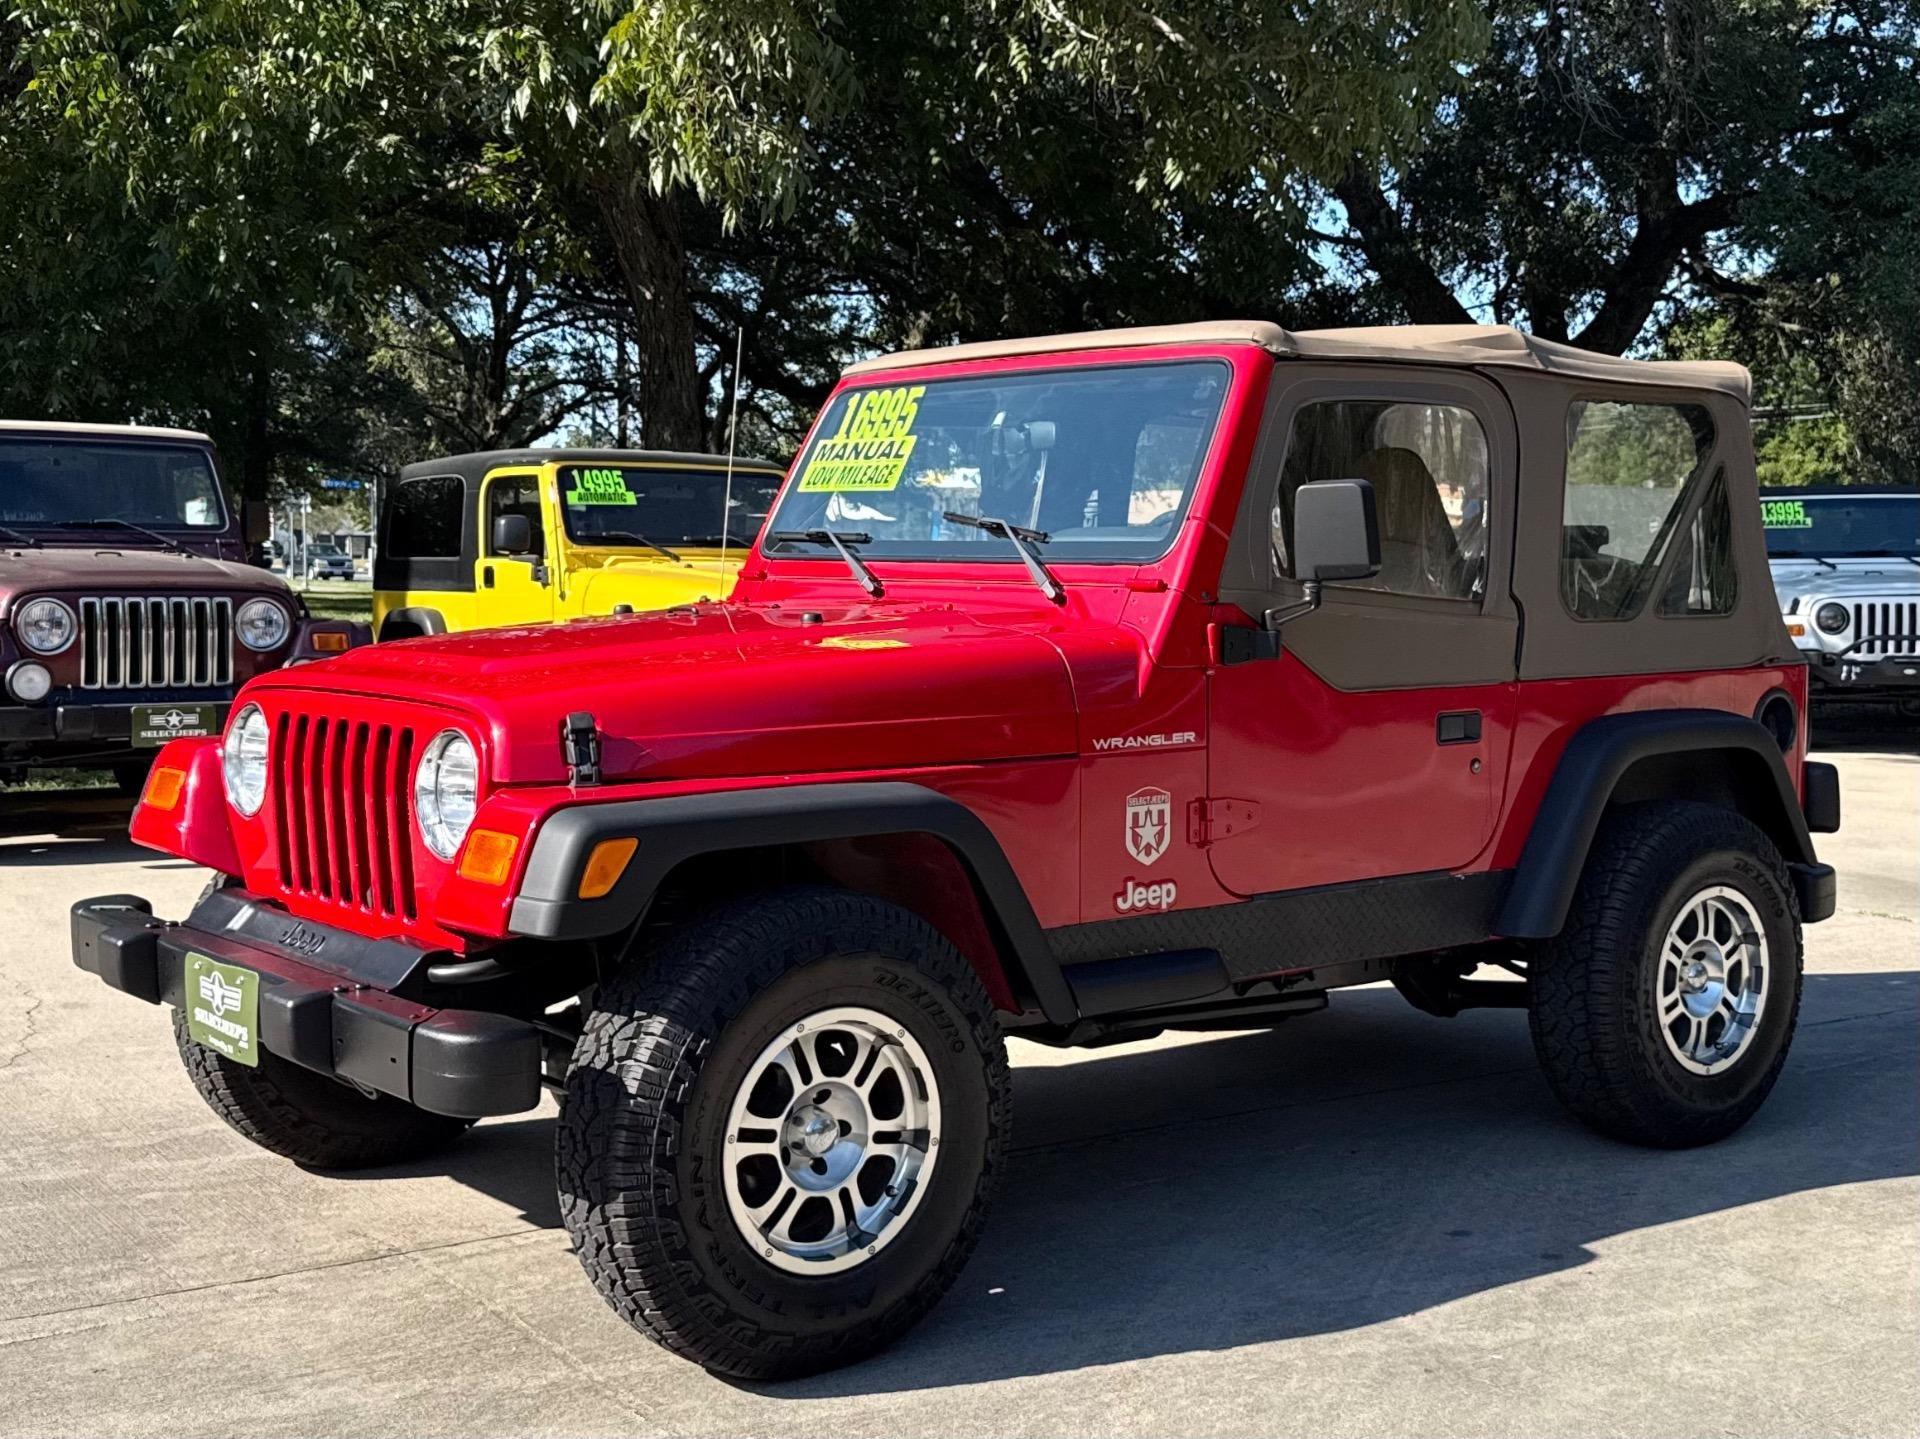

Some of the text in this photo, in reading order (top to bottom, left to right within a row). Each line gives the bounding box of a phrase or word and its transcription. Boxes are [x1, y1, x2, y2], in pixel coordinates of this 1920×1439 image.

[833, 385, 926, 440] 16995
[814, 439, 907, 462] MANUAL
[571, 469, 627, 492] 14995
[805, 463, 899, 487] LOW MILEAGE
[577, 491, 628, 503] AUTOMATIC
[1760, 501, 1805, 521] 13995
[140, 728, 208, 739] SELECTJEEPS
[1092, 731, 1196, 750] WRANGLER
[1116, 881, 1177, 910] Jeep
[278, 921, 326, 956] Jeep
